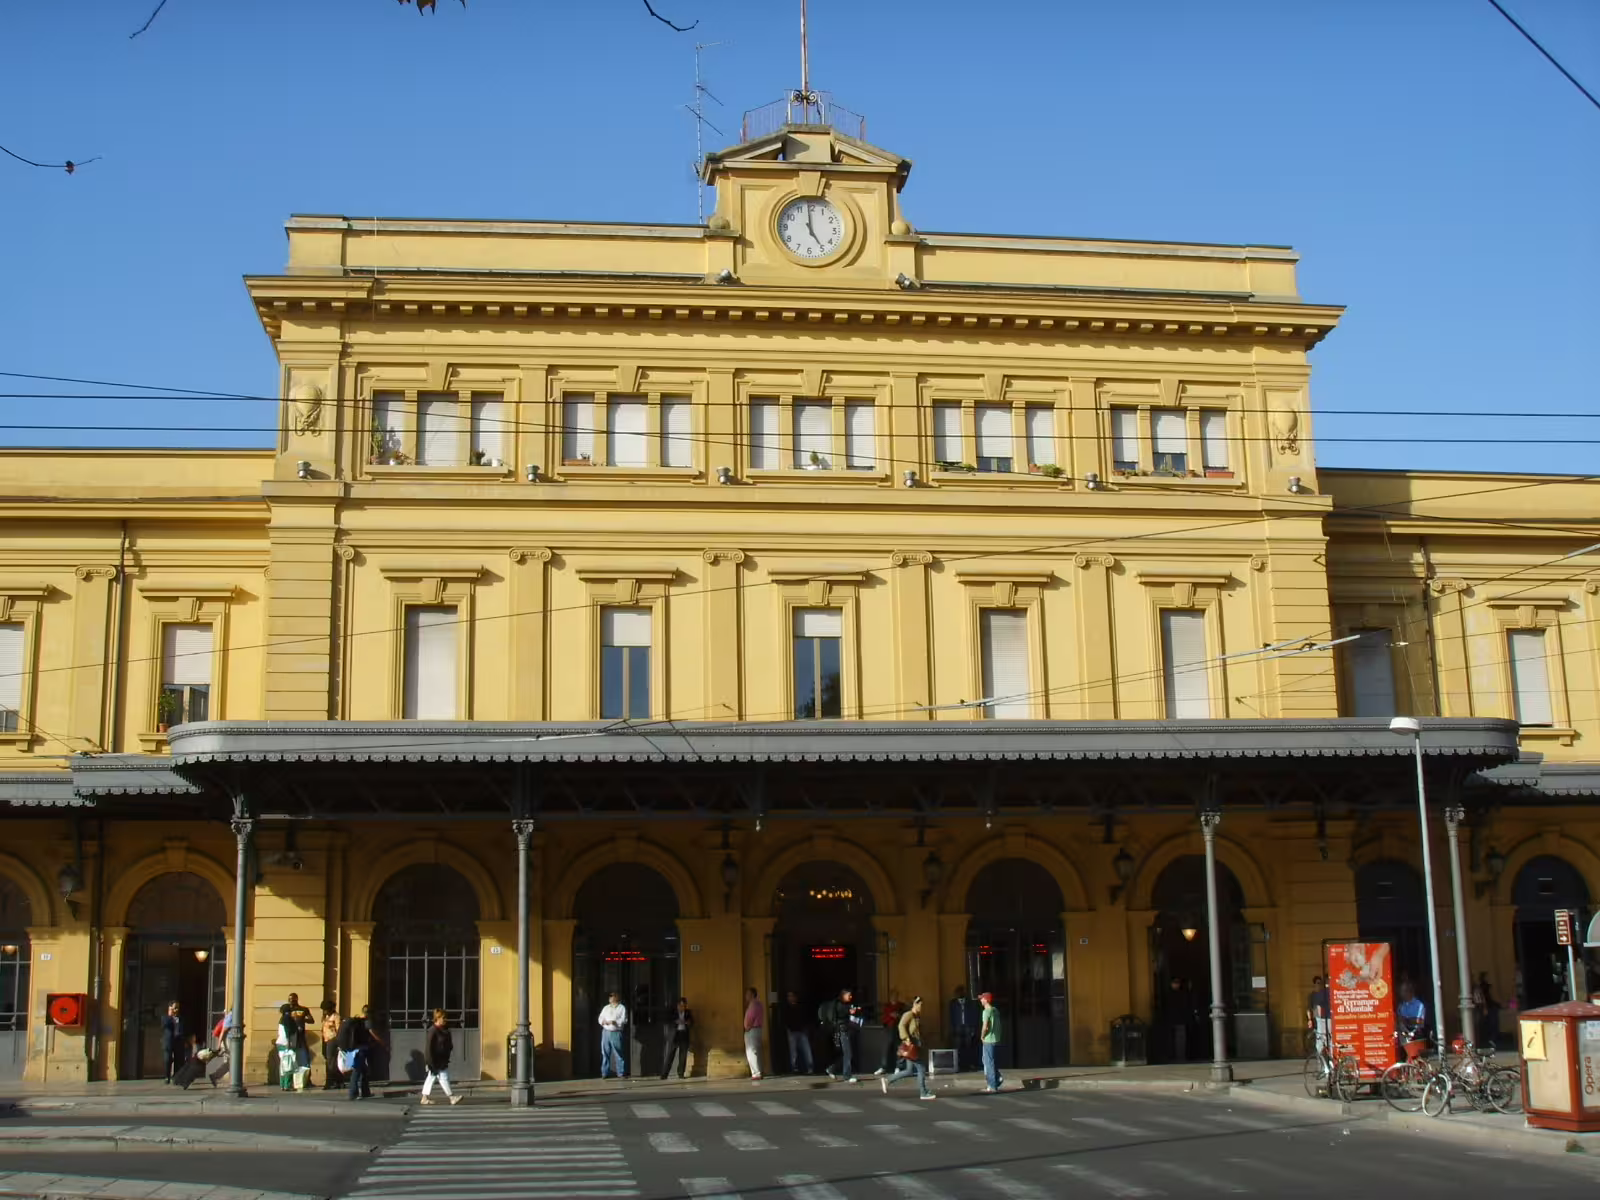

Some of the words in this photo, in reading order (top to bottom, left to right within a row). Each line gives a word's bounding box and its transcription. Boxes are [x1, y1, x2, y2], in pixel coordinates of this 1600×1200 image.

[787, 213, 795, 221] 10
[828, 216, 834, 224] 2
[783, 223, 788, 231] 9
[832, 227, 837, 235] 3
[796, 243, 801, 251] 7
[1346, 1004, 1373, 1012] Montale
[1585, 1056, 1595, 1095] Opera
